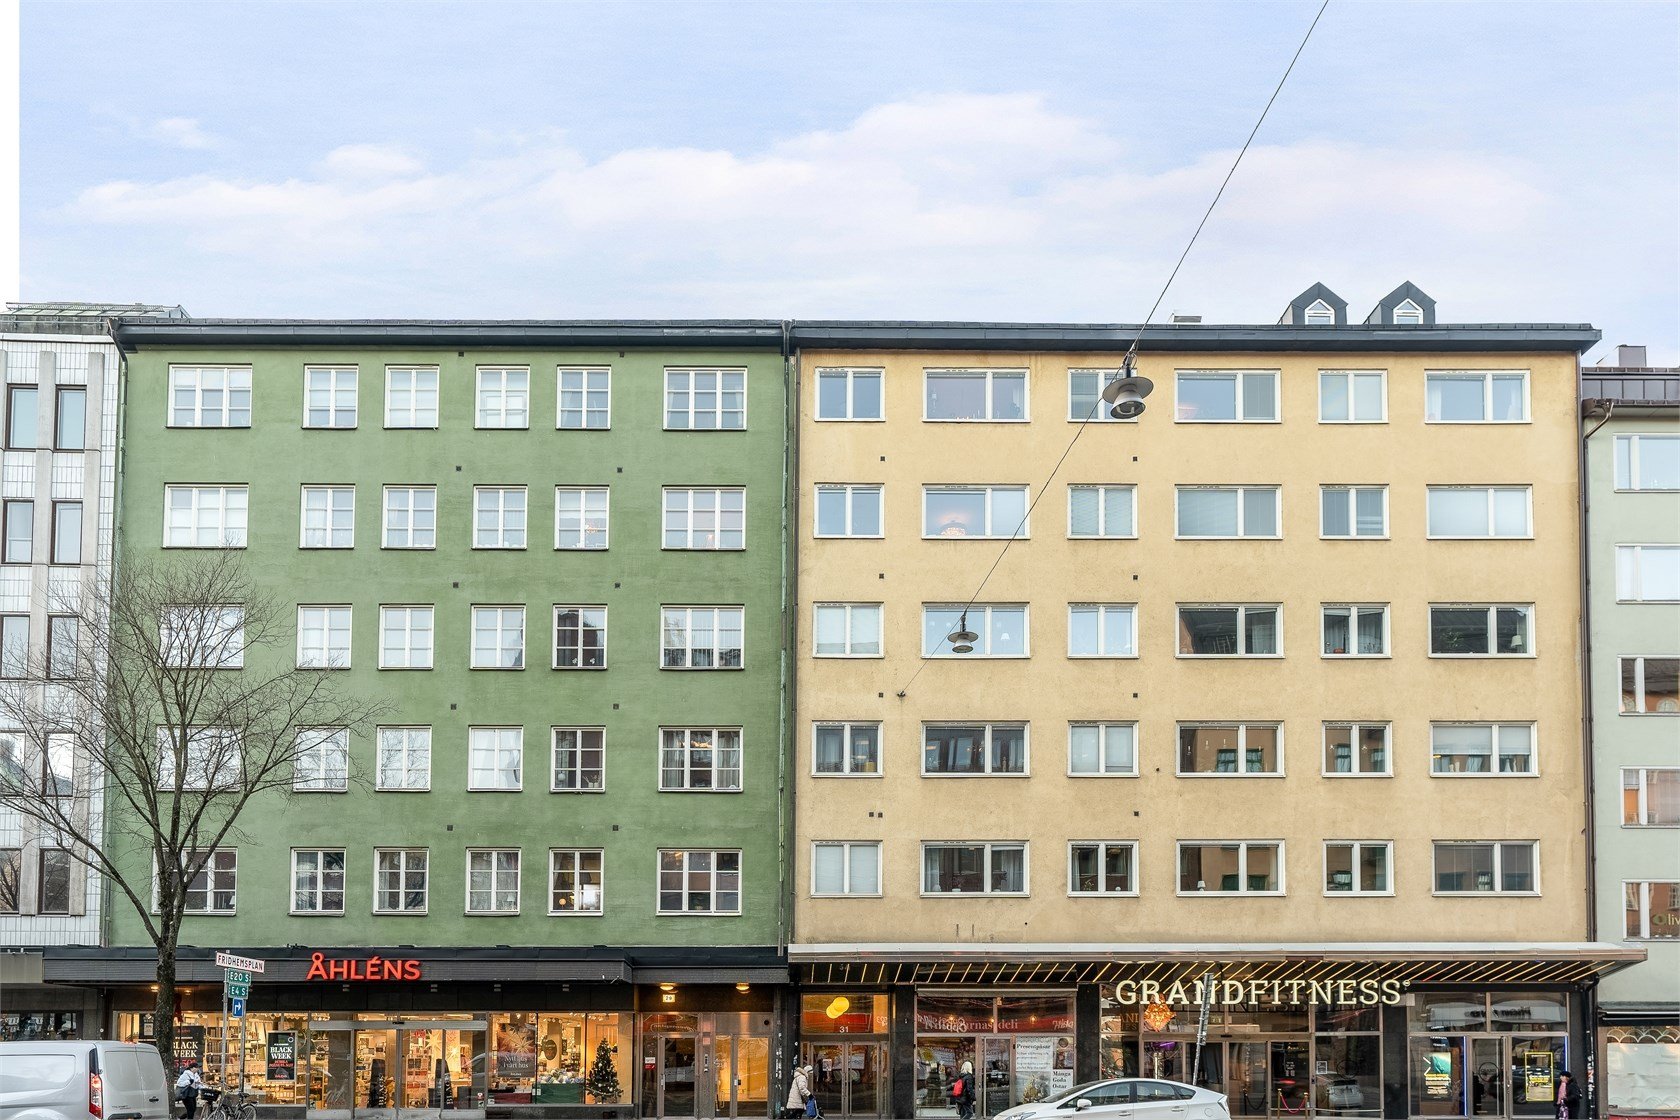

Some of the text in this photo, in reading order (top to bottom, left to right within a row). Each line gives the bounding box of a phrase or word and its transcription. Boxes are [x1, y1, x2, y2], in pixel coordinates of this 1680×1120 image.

[217, 954, 263, 971] FRIDHEMSPLAN
[306, 952, 421, 980] ÅHLÉNS
[230, 971, 250, 983] E20 S
[231, 986, 246, 996] E4 S
[839, 1025, 849, 1033] 31
[998, 1019, 1019, 1029] deli
